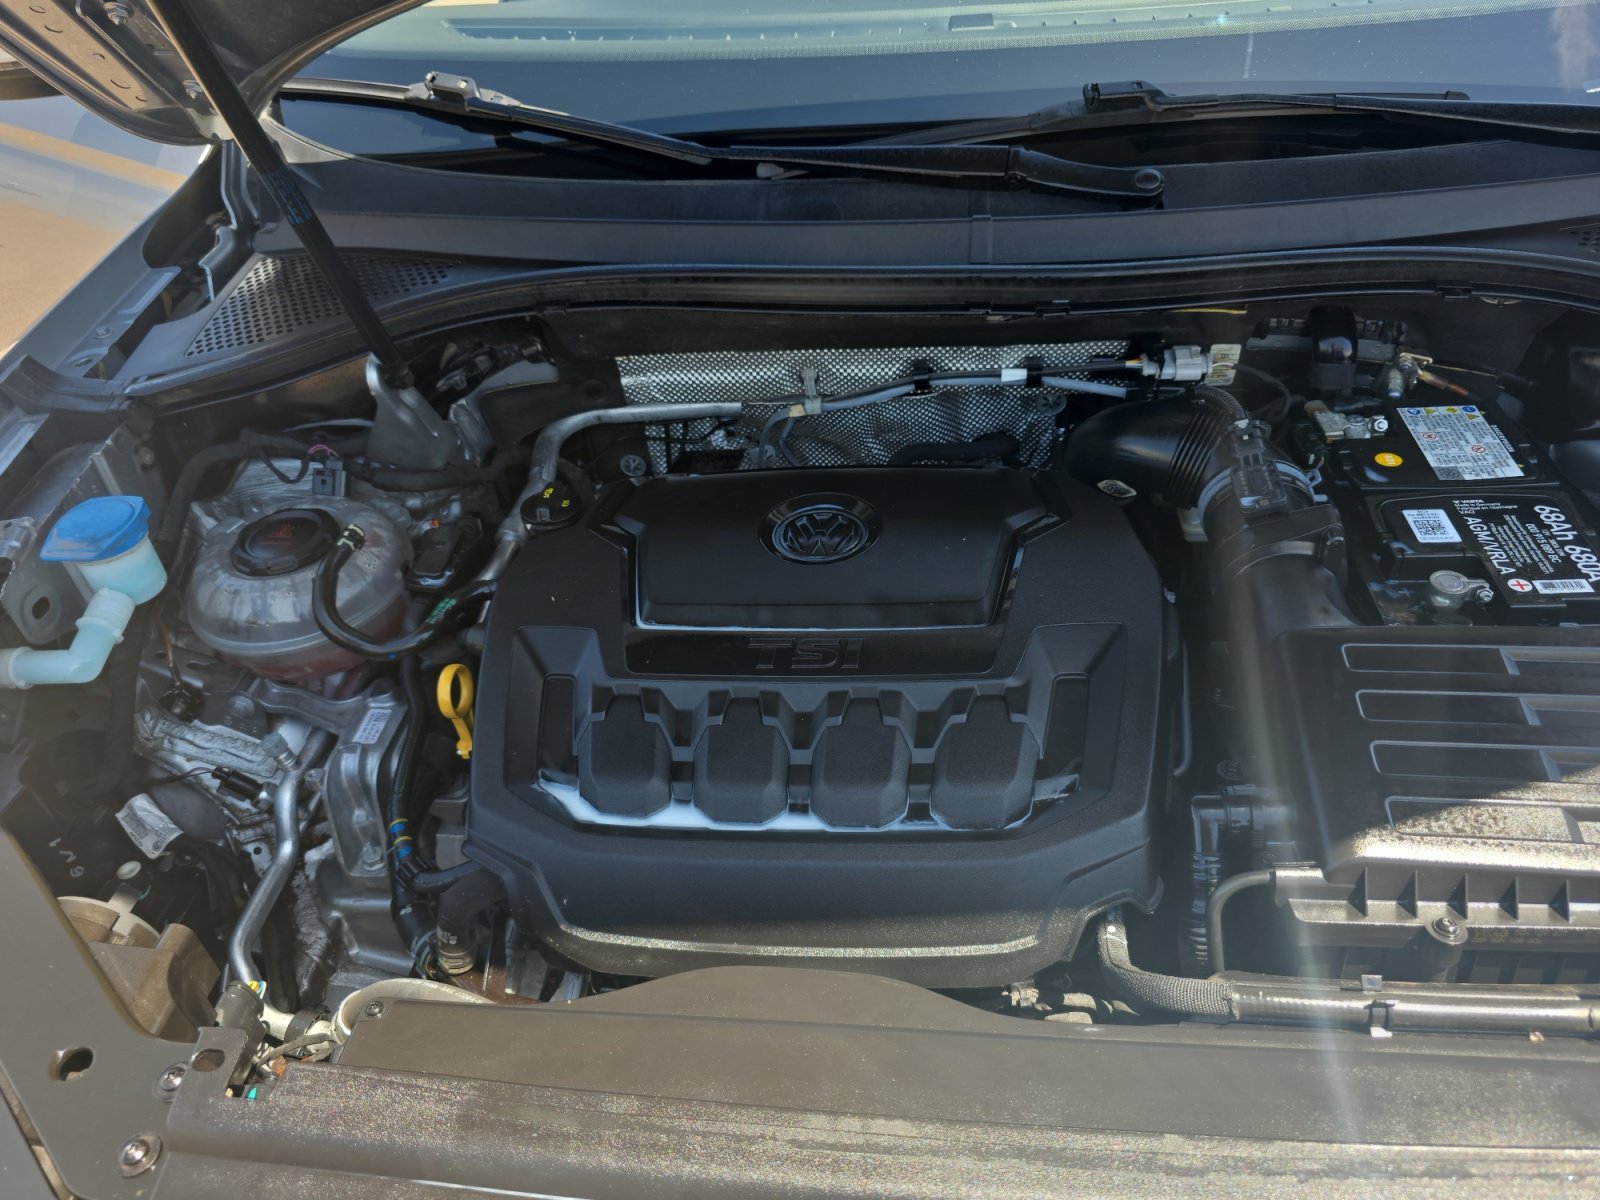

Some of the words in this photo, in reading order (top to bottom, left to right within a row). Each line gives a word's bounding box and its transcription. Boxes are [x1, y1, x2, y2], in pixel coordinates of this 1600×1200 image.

[1463, 516, 1517, 575] AGM/VRLA
[1533, 533, 1548, 544] 915
[1533, 505, 1578, 541] 68Ah
[1563, 545, 1600, 582] 680A
[747, 637, 864, 669] TSI
